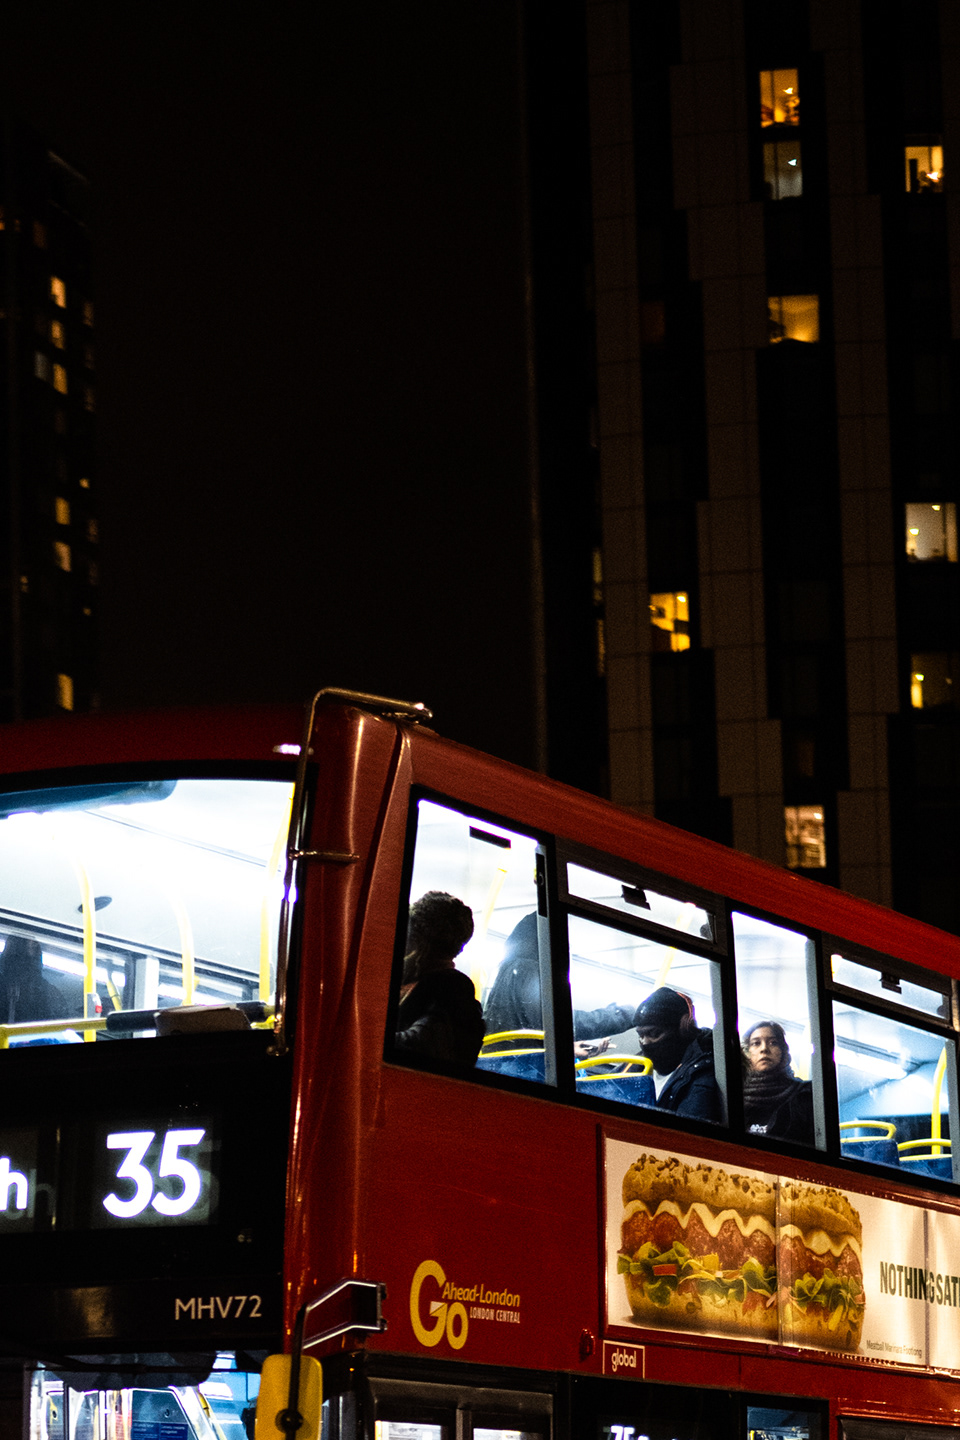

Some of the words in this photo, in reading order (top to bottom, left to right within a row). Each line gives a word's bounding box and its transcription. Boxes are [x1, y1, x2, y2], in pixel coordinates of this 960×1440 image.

[102, 1129, 206, 1218] 35
[410, 1260, 469, 1350] Go
[442, 1282, 520, 1307] Ahead-London
[174, 1295, 262, 1320] MHV72
[470, 1307, 495, 1320] LONDON
[496, 1310, 520, 1324] CENTRAL
[611, 1348, 637, 1372] global
